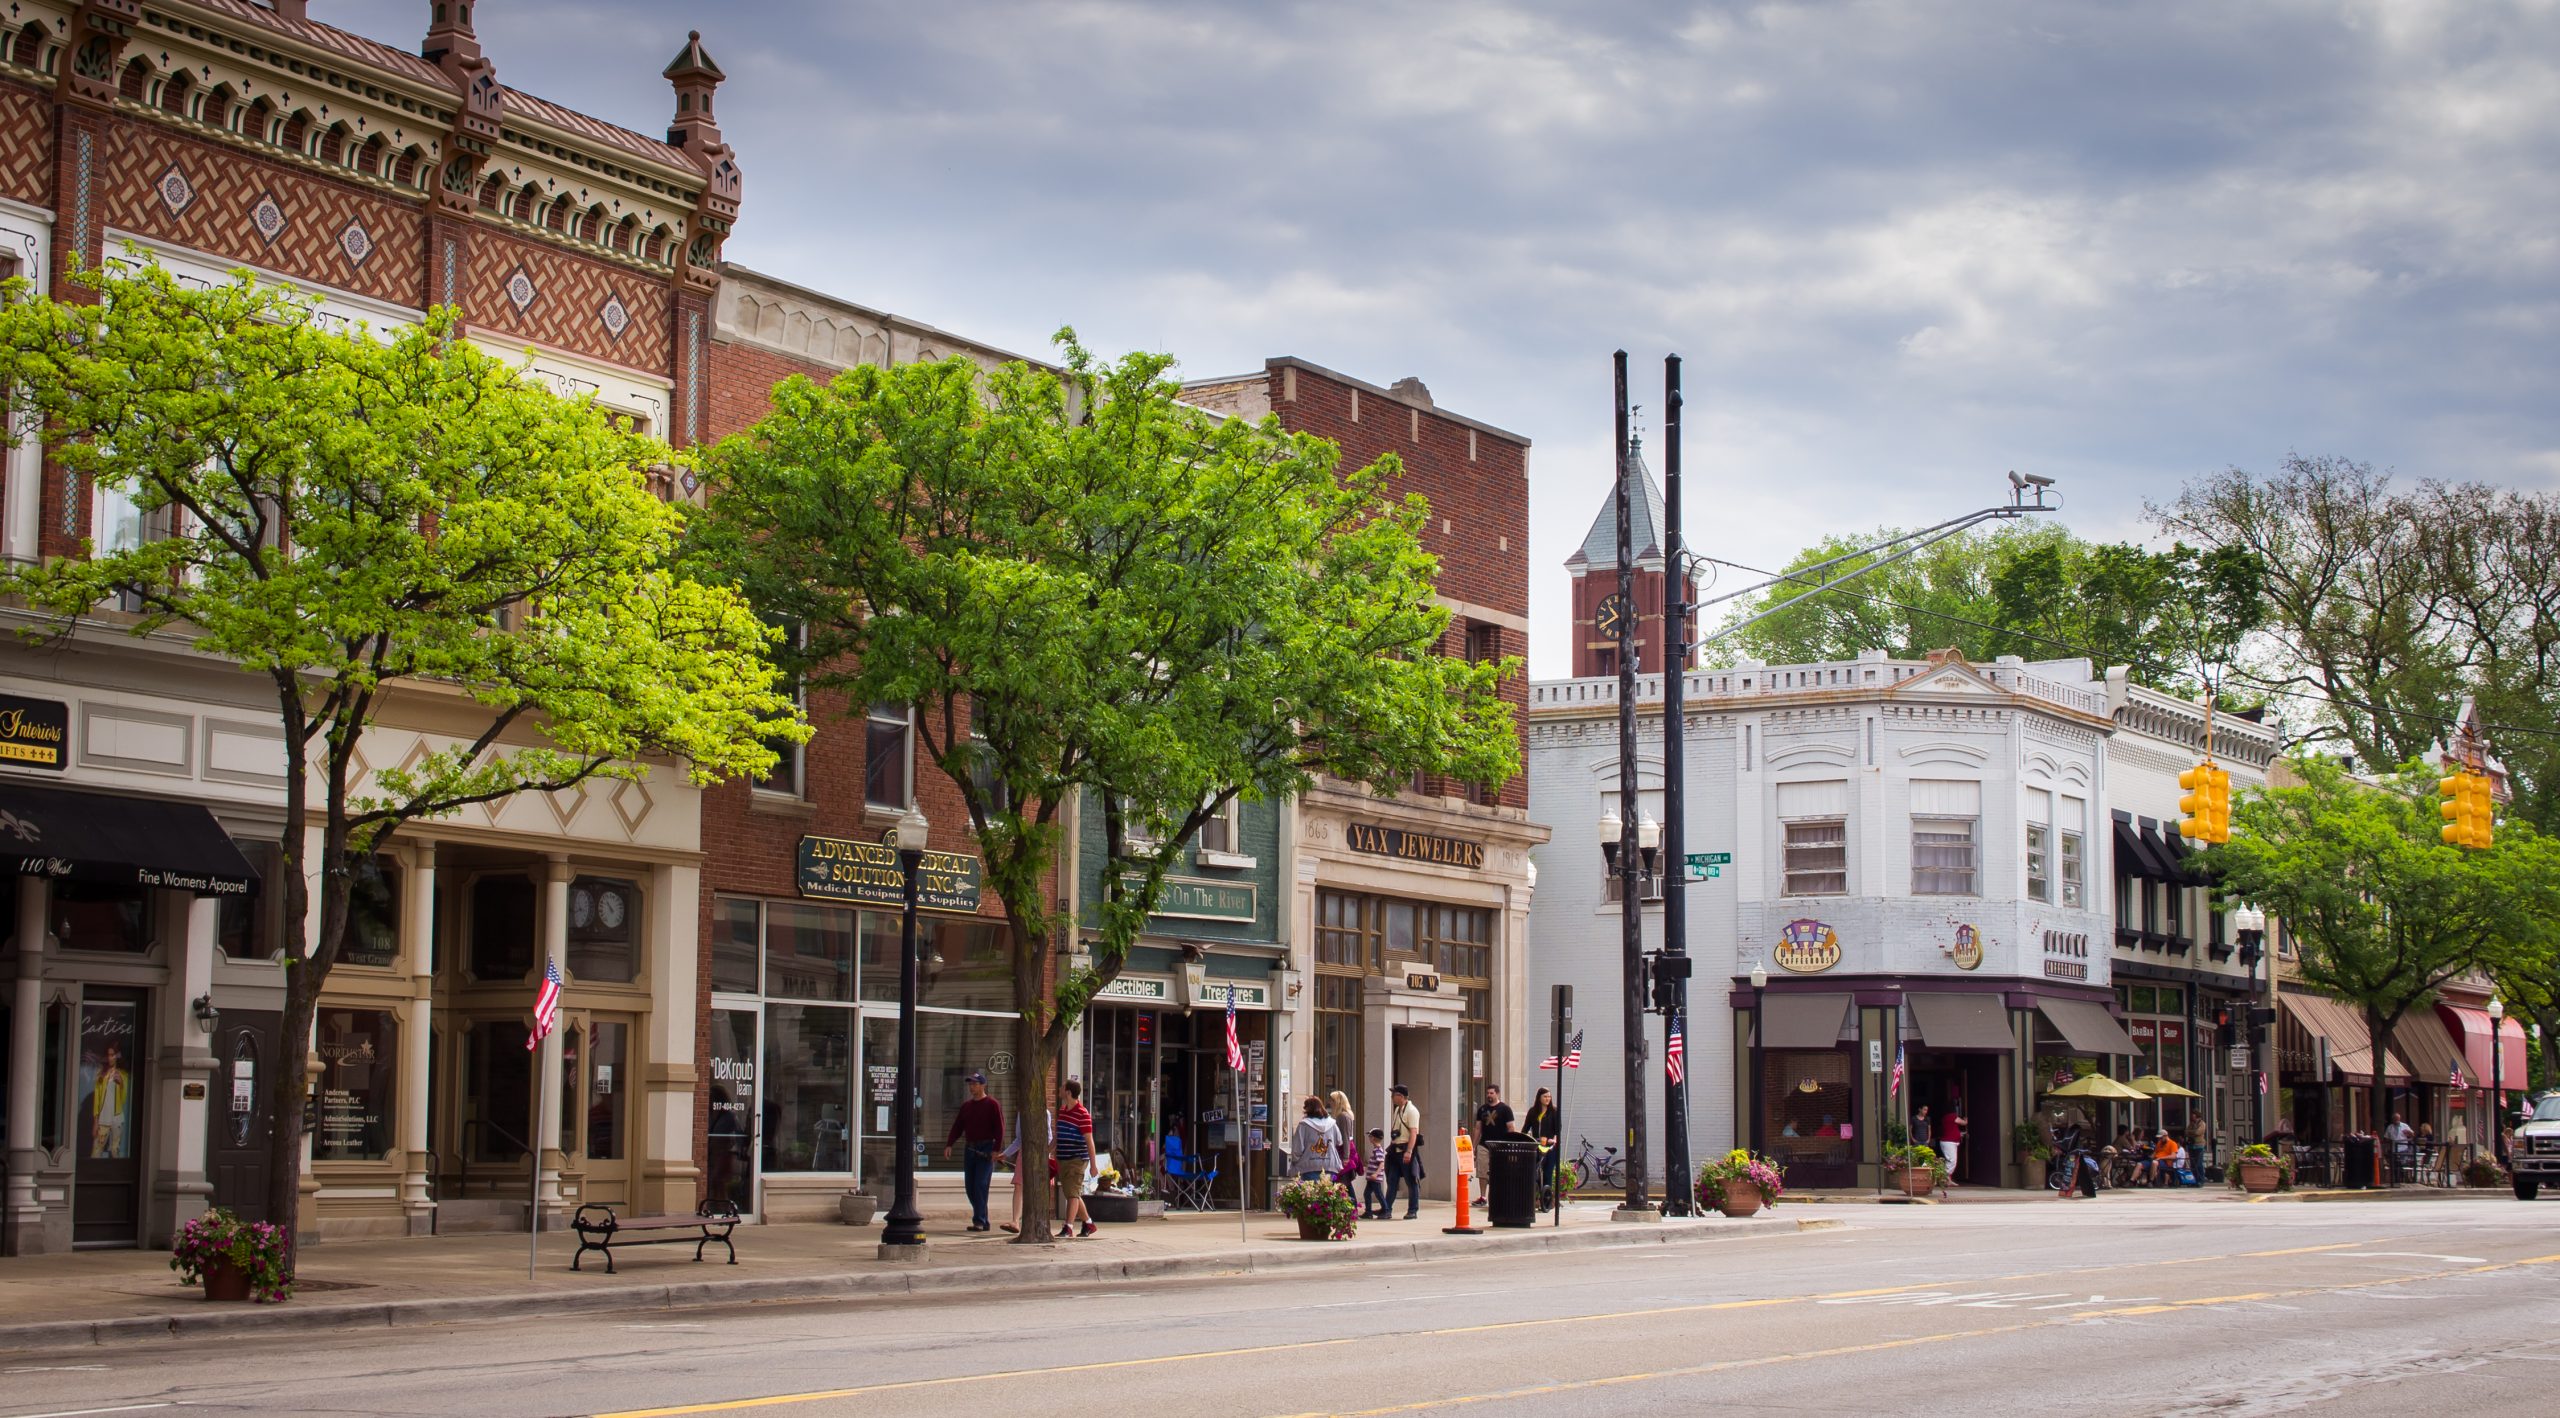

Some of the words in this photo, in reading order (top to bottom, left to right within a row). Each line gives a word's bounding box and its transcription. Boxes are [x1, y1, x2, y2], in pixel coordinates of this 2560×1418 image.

[1304, 822, 1328, 840] 1865
[1354, 825, 1389, 853] YAX
[1399, 831, 1483, 867] JEWELERS
[20, 858, 44, 873] 110
[47, 857, 73, 876] West
[811, 841, 896, 866] ADVANCED
[917, 853, 971, 875] EDICAL
[1695, 855, 1722, 863] MICHIGAN
[139, 868, 160, 886] Fine
[163, 871, 207, 890] Womens
[209, 876, 248, 894] Apparel
[832, 863, 921, 893] SOLUTION,
[926, 874, 955, 894] INC.
[917, 894, 926, 903] &
[1173, 886, 1190, 906] On
[1193, 887, 1214, 907] The
[1218, 890, 1246, 910] River
[373, 936, 391, 950] 108
[1411, 975, 1424, 988] 102
[1205, 985, 1254, 1002] Treaures
[714, 1056, 754, 1080] DeKroub
[989, 1055, 1014, 1070] OPEN
[324, 1088, 350, 1096] Anderson
[736, 1080, 753, 1096] Team
[1203, 1109, 1223, 1121] OPEN
